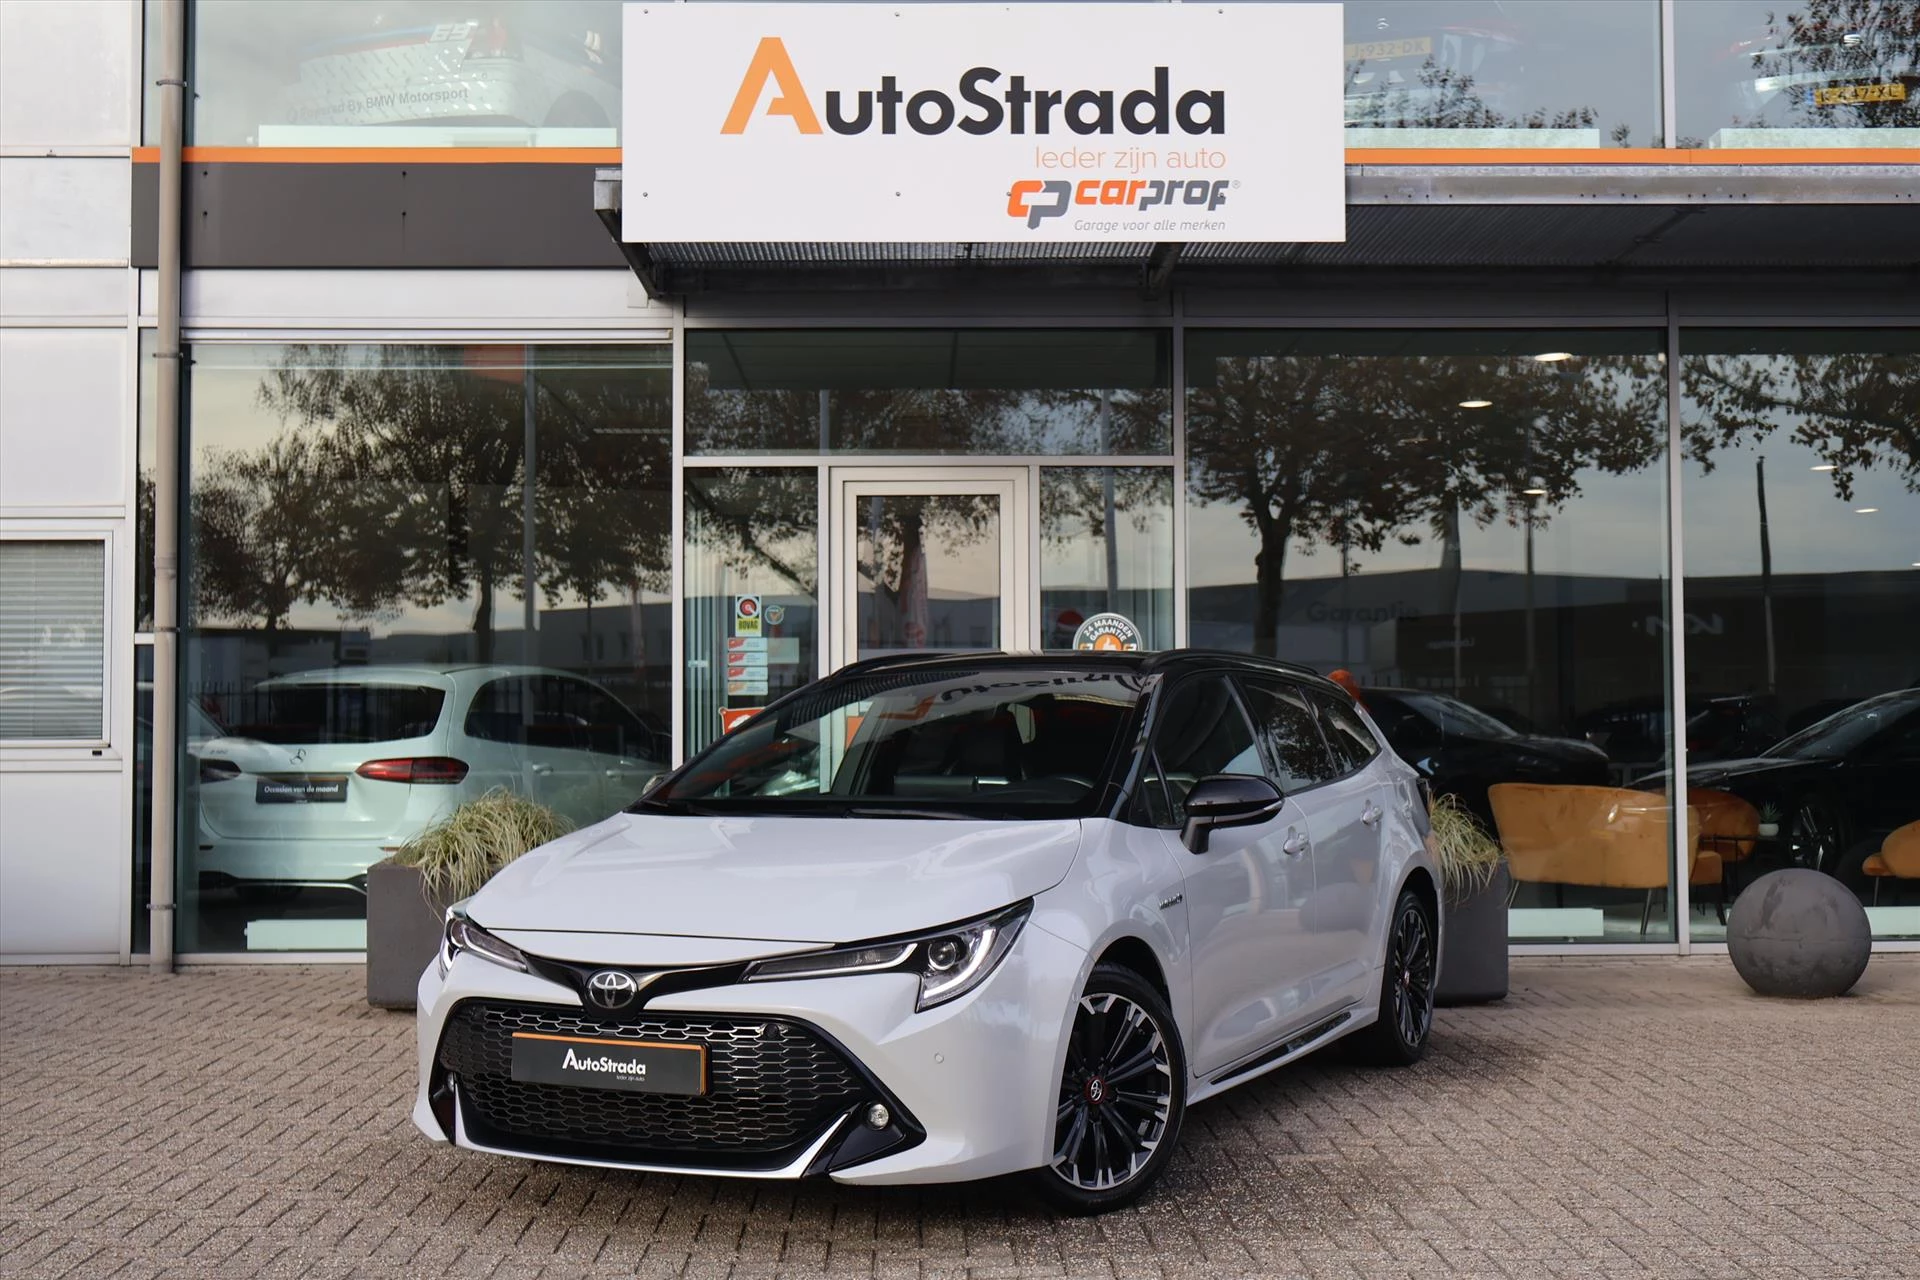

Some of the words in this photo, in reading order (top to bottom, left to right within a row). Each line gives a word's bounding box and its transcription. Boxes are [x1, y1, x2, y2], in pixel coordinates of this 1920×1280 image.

[719, 36, 1226, 136] AutoStrada
[348, 98, 363, 113] By
[366, 94, 396, 109] BMW
[399, 87, 469, 104] Motorsport
[1035, 146, 1107, 169] Ieder
[1114, 146, 1157, 174] zijn
[1166, 148, 1227, 169] auto
[1074, 219, 1119, 233] Garage
[1122, 221, 1151, 232] voor
[1153, 219, 1177, 231] alle
[1180, 219, 1226, 231] merken
[1083, 625, 1094, 637] 24
[1094, 619, 1134, 637] MAANDEN
[1089, 626, 1128, 642] GARANTIE
[316, 784, 339, 793] maand
[562, 1048, 646, 1075] AutoStrada
